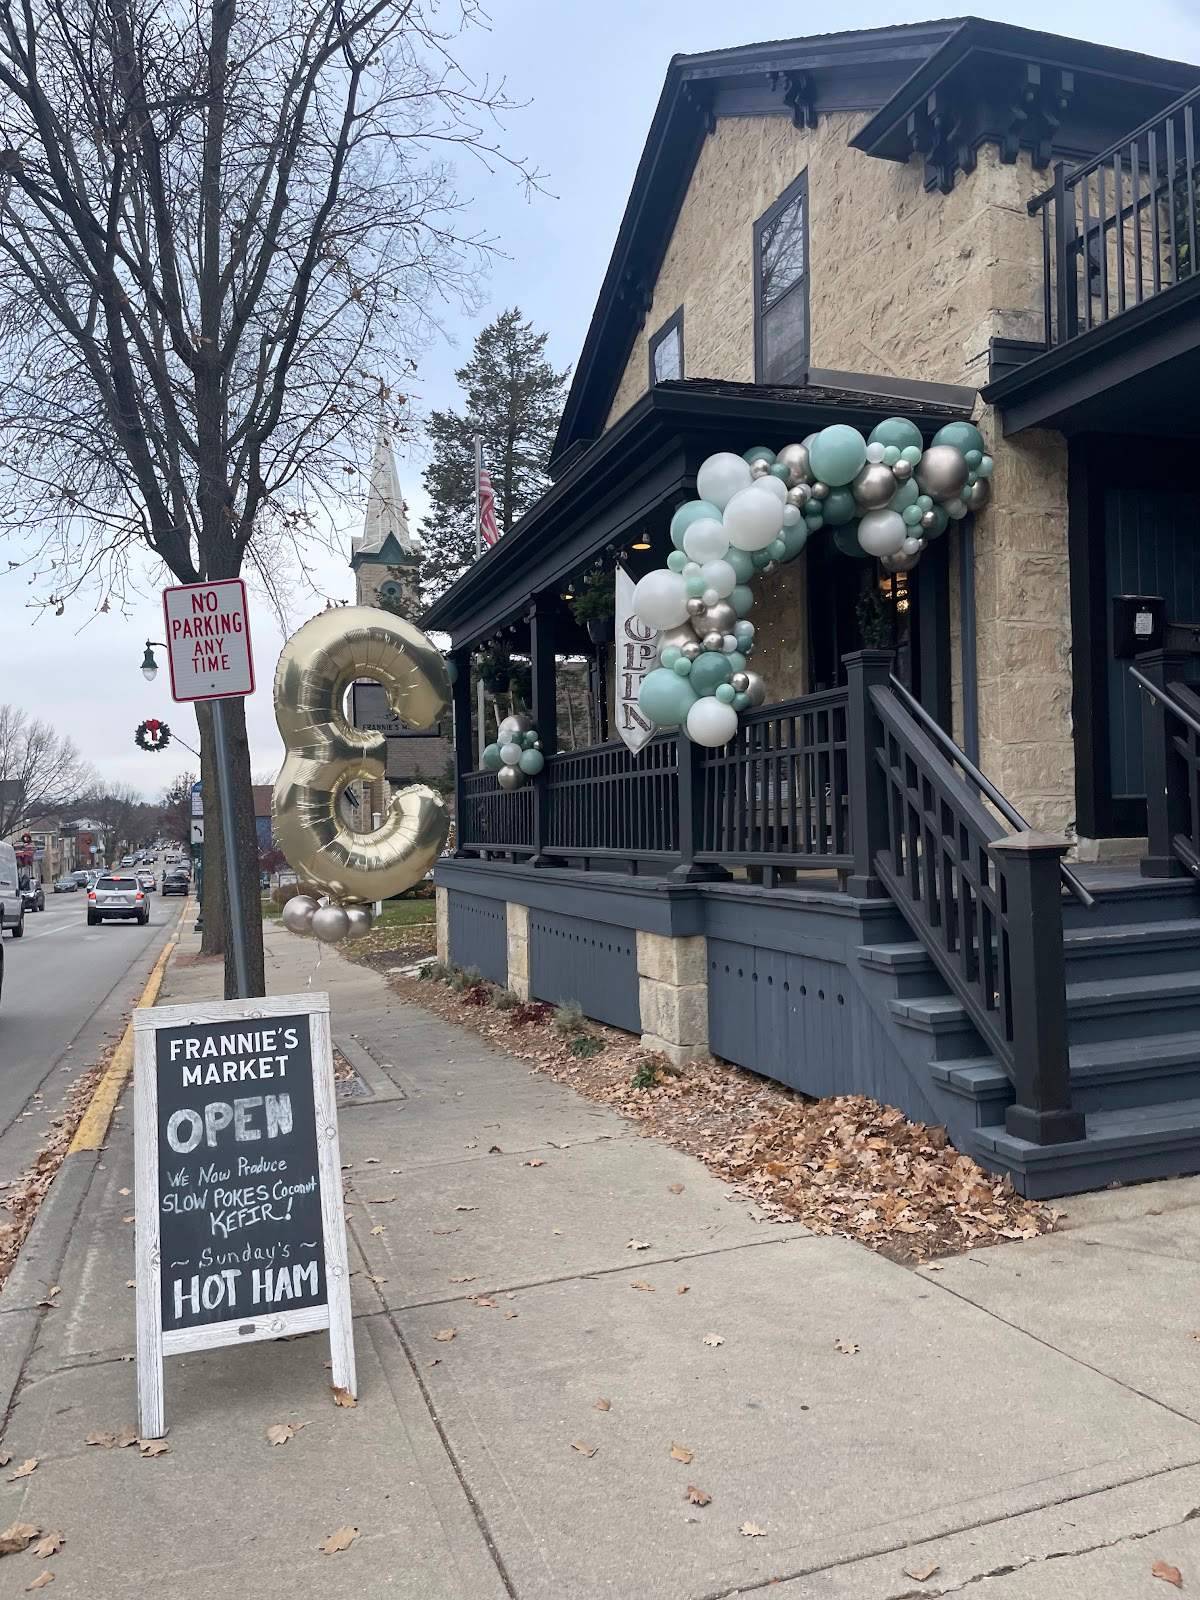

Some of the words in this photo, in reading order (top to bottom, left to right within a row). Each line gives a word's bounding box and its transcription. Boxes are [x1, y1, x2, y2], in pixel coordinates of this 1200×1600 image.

[191, 591, 218, 614] NO
[172, 612, 242, 640] PARKING
[194, 638, 224, 656] ANY
[192, 654, 231, 674] TIME
[170, 1027, 299, 1061] FRANNIE'S
[182, 1055, 289, 1087] MARKET
[166, 1093, 294, 1154] OPEN
[198, 1163, 231, 1187] Now
[238, 1156, 288, 1177] Produce
[162, 1189, 208, 1214] SLOW
[214, 1184, 269, 1209] POKES
[272, 1175, 318, 1201] Coconut
[210, 1196, 293, 1239] KEFIR!
[199, 1242, 291, 1269] Sunday's
[173, 1268, 242, 1320] HOT
[252, 1260, 320, 1305] HAM
